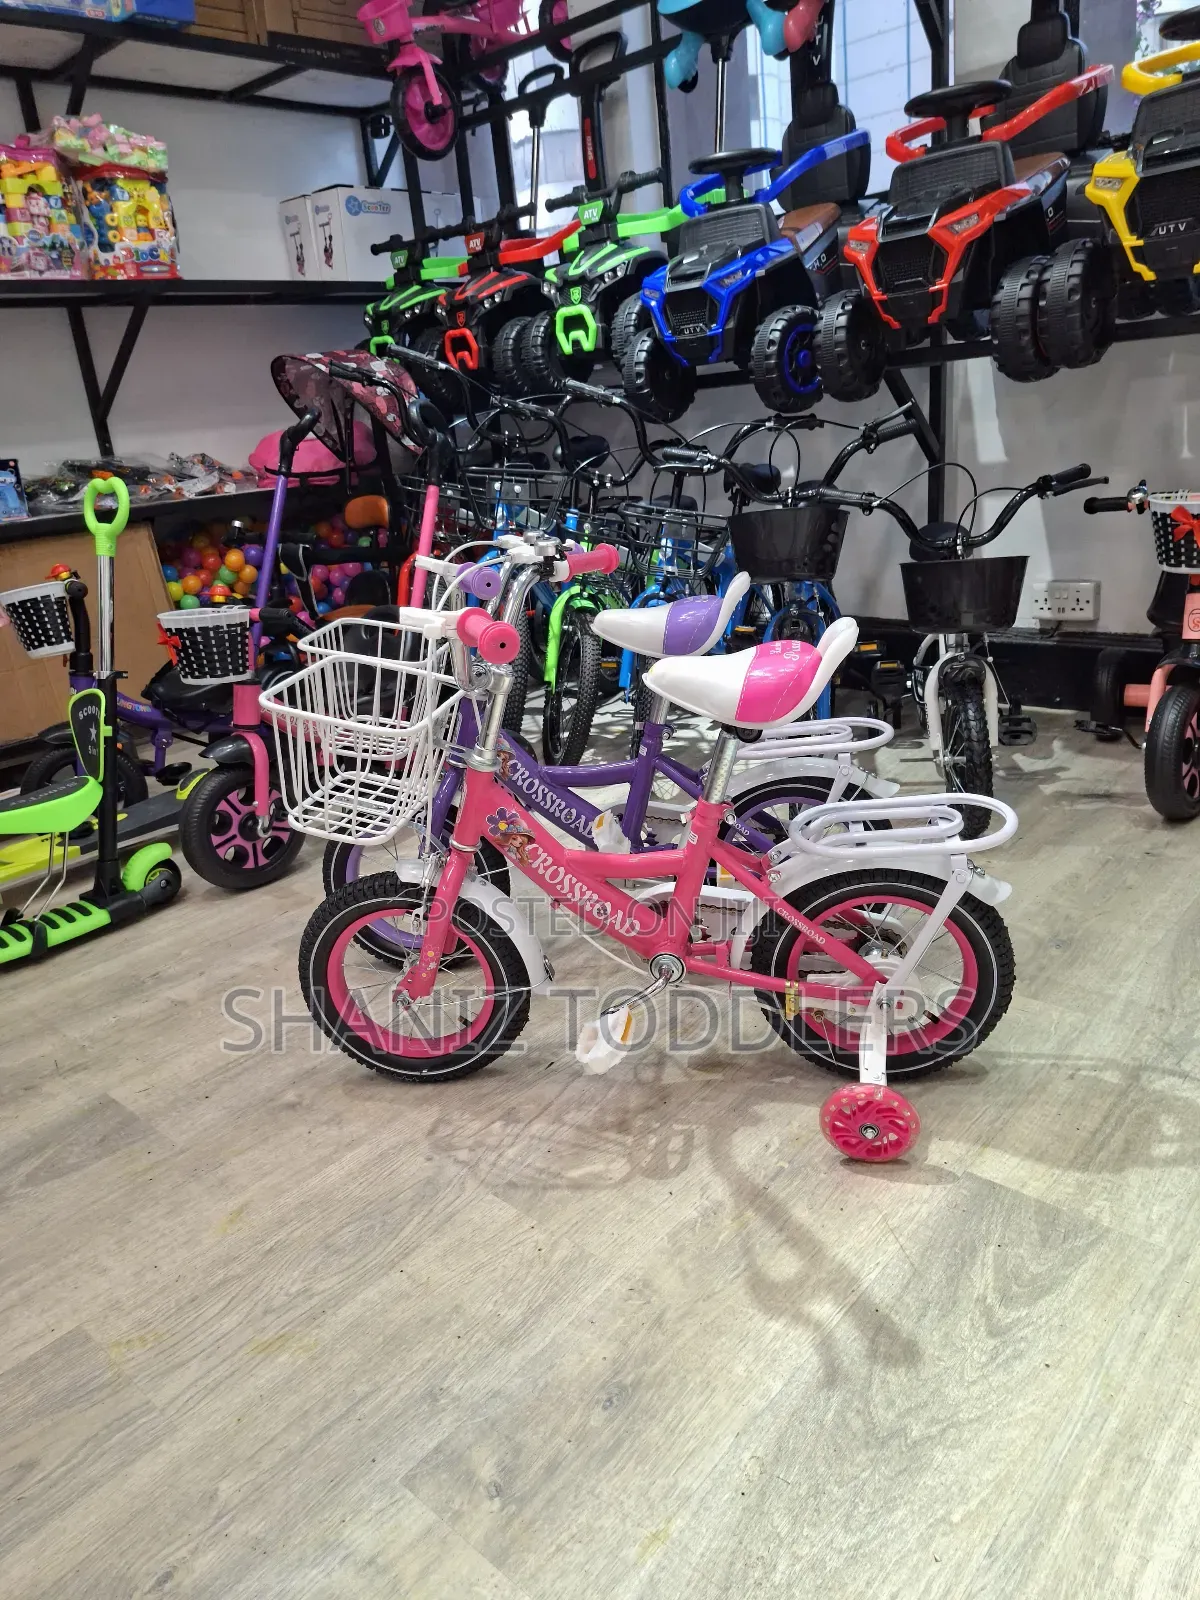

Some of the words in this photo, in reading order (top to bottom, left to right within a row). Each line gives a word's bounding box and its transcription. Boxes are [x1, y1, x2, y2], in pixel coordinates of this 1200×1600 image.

[583, 207, 598, 219] ATV
[1158, 222, 1187, 235] UTV
[469, 237, 481, 248] ATV
[394, 254, 405, 265] ATV
[683, 326, 701, 335] UTV
[524, 843, 641, 937] CROSSROAD
[776, 907, 826, 945] CROSSROAD
